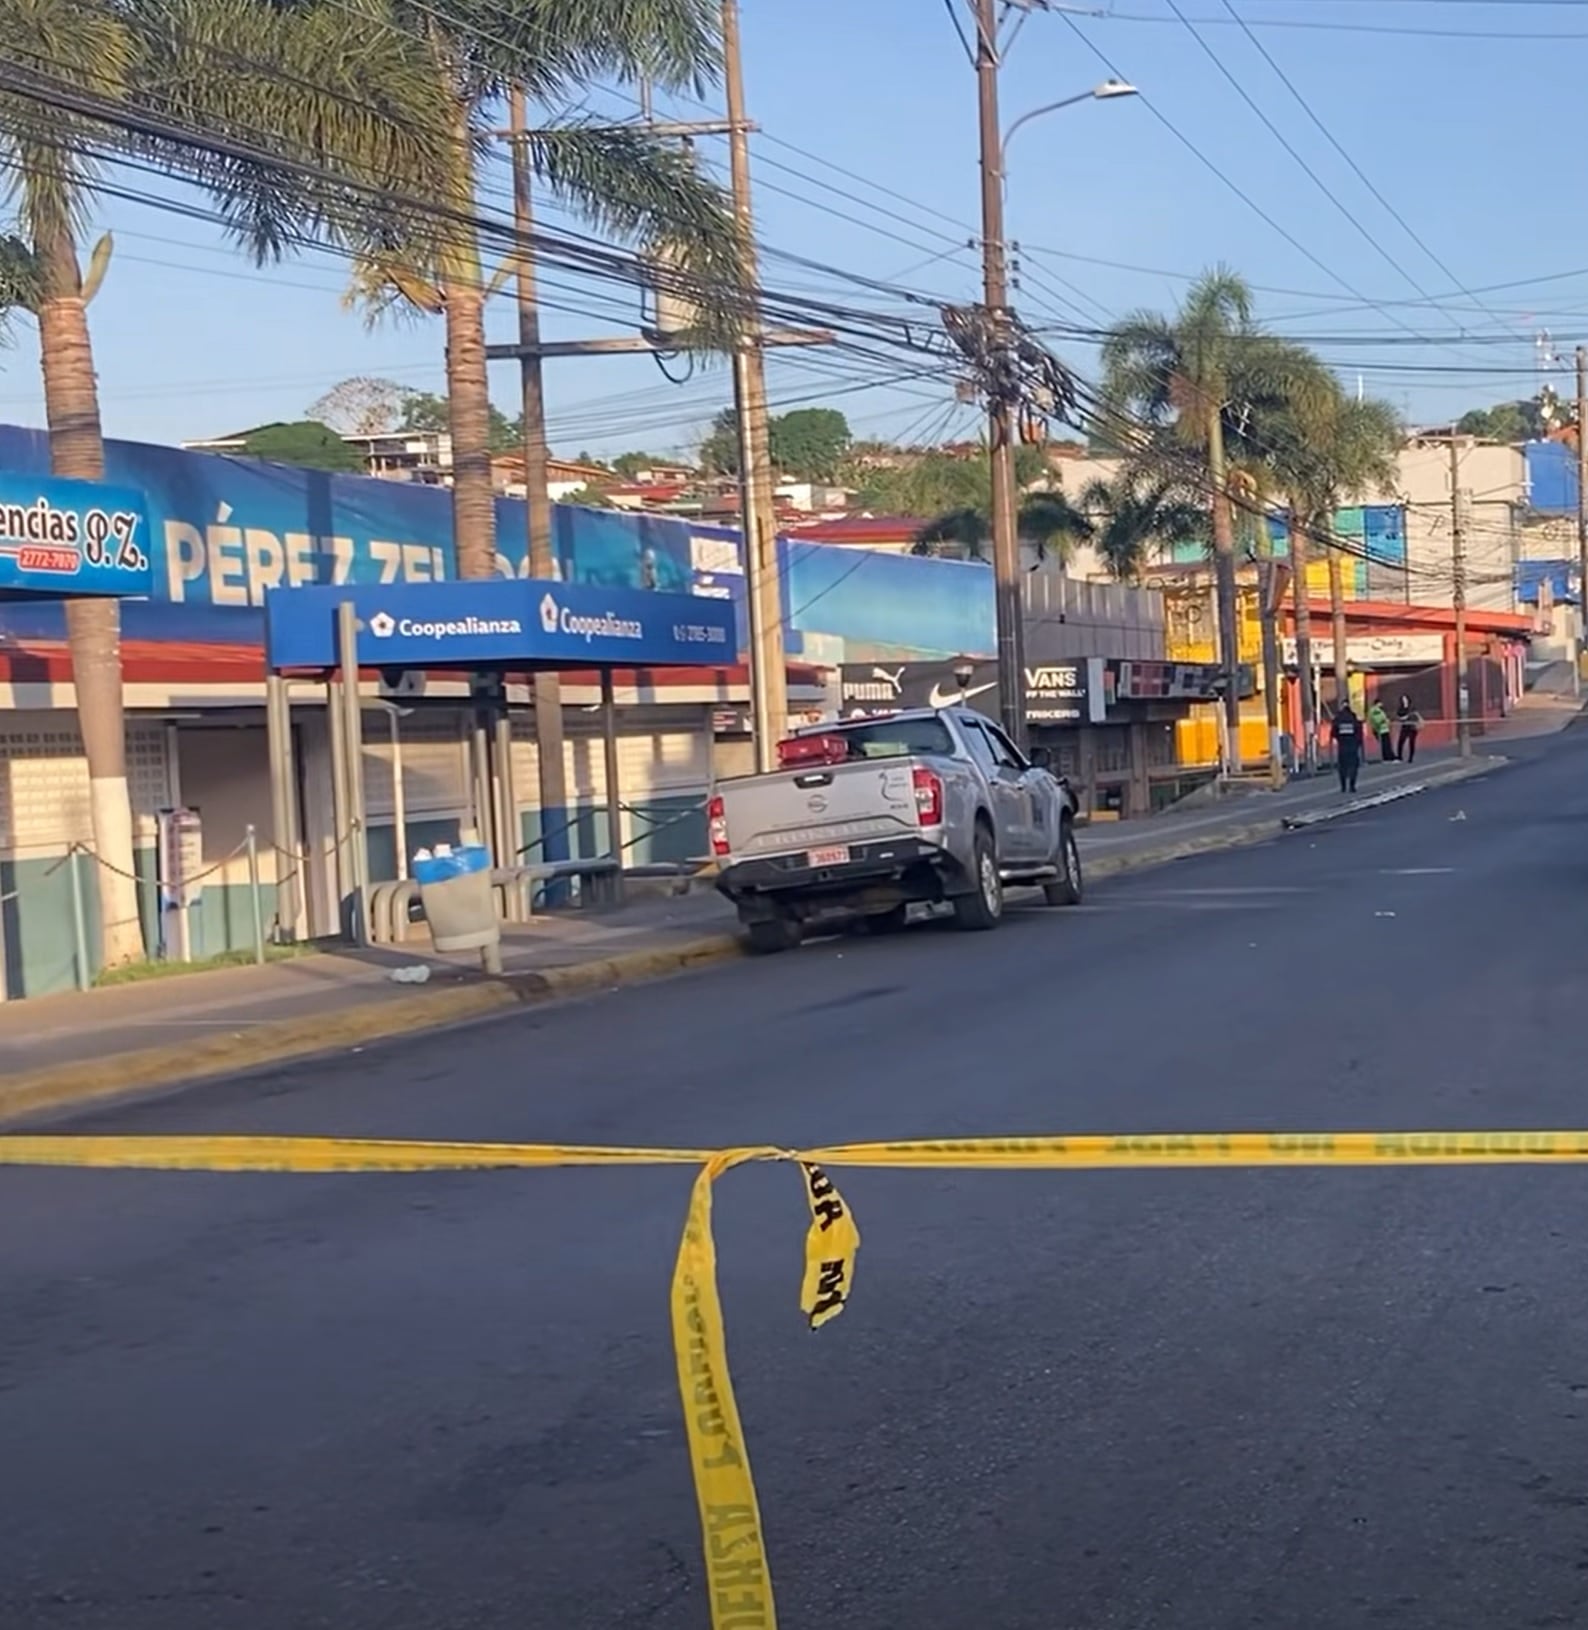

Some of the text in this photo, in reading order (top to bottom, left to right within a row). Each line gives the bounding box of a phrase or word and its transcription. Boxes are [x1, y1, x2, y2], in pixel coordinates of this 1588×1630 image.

[163, 500, 354, 607] PÉREZ
[399, 616, 521, 639] Coopealianza
[560, 607, 643, 642] Coopealianza
[1024, 667, 1077, 688] VANS
